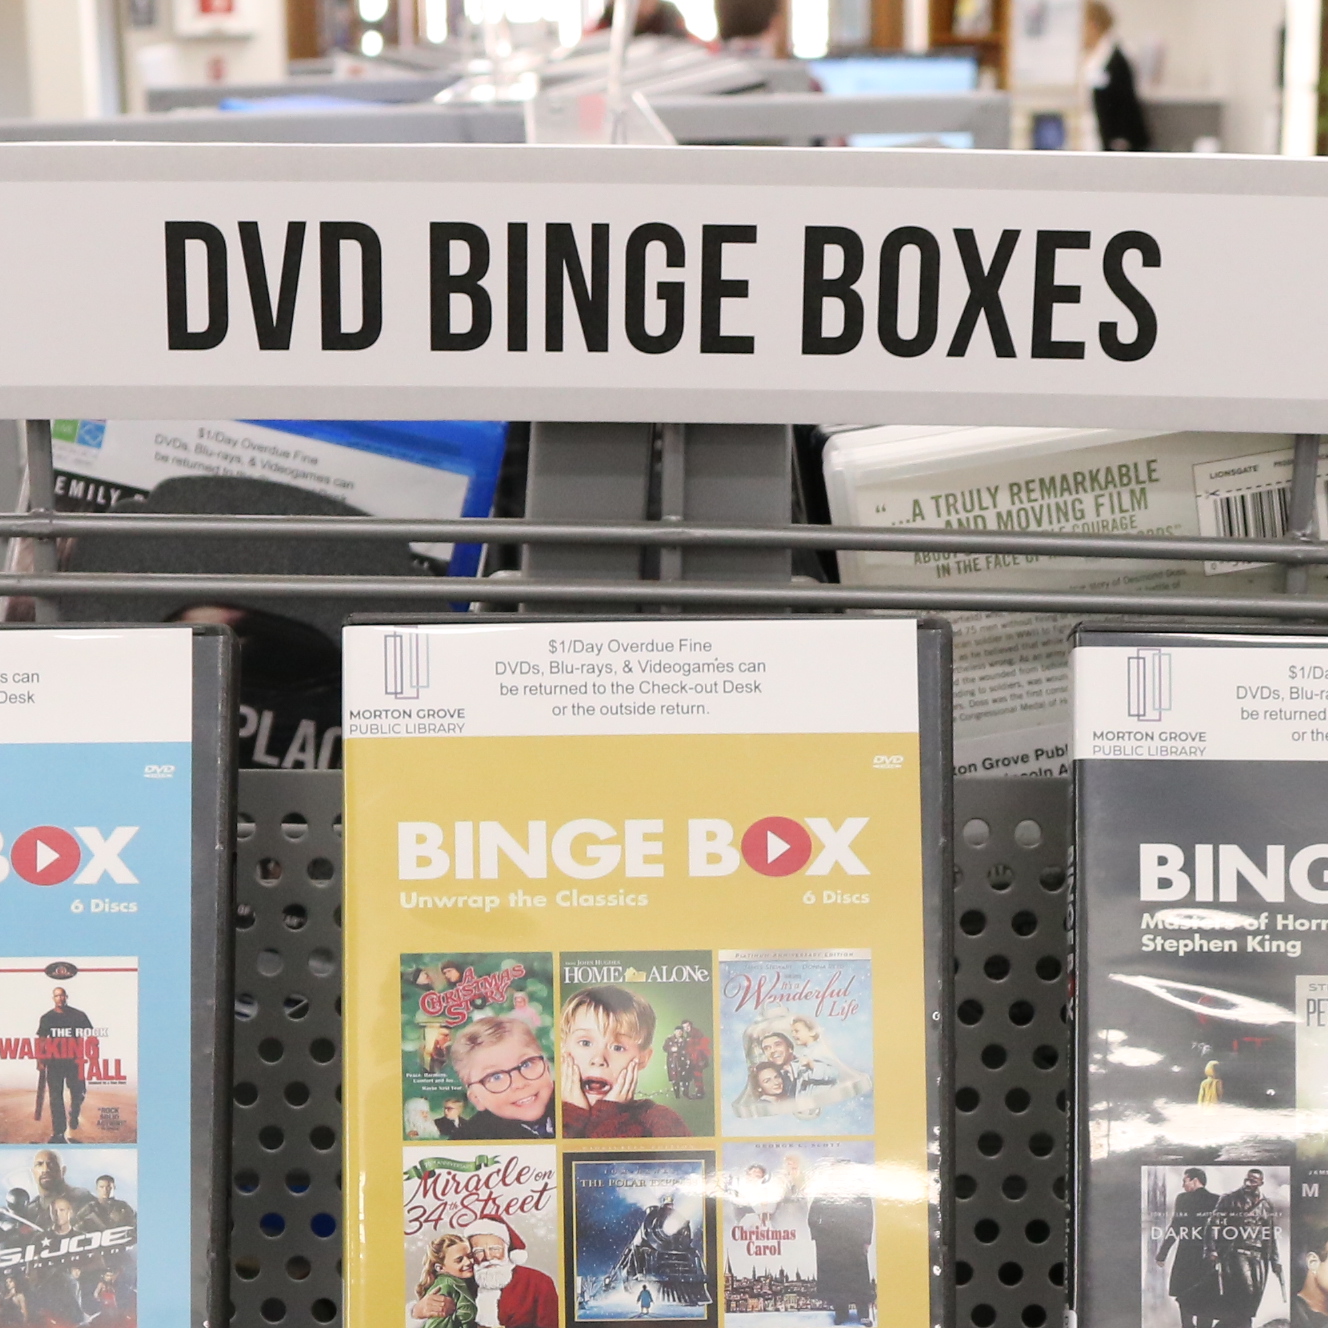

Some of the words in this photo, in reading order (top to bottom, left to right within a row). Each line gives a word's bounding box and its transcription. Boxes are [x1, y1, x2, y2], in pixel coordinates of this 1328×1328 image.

[164, 219, 386, 353] DVD
[429, 222, 757, 359] BINGE
[801, 226, 1163, 363] BOXES
[1209, 464, 1258, 480] LIONSGATE
[930, 486, 999, 520] TRULY
[1008, 459, 1160, 505] REMARKABLE
[996, 496, 1086, 532] MOVING
[1095, 486, 1148, 517] FILM
[548, 639, 603, 655] $1/Day
[607, 639, 674, 654] Overdue
[678, 639, 712, 654] Fine
[495, 660, 544, 677] DVDs,
[549, 659, 617, 676] Blu-rays,
[622, 660, 633, 673] &
[637, 659, 733, 676] Videogames
[738, 661, 766, 673] can
[500, 681, 519, 696] be
[524, 680, 586, 695] returned
[591, 681, 603, 695] to
[607, 680, 634, 695] the
[639, 680, 718, 695] Check-out
[723, 679, 762, 694] Desk
[1236, 686, 1285, 703] DVDs,
[350, 708, 410, 720] MORTON
[417, 708, 465, 719] GROVE
[552, 705, 567, 716] or
[571, 702, 594, 716] the
[599, 701, 656, 716] outside
[661, 702, 710, 715] return.
[1241, 707, 1260, 722] be
[1264, 707, 1326, 722] returned
[350, 723, 401, 735] PUBLIC
[406, 722, 465, 734] LIBRARY
[1093, 731, 1154, 742] MORTON
[1160, 731, 1206, 742] GROVE
[1292, 731, 1306, 742] or
[1093, 745, 1143, 756] PUBLIC
[1148, 745, 1206, 756] LIBRARY
[397, 819, 664, 880] BINGE
[688, 816, 871, 877] BOX
[400, 891, 500, 912] Unwrap
[510, 890, 547, 908] the
[555, 890, 648, 908] Classics
[803, 890, 815, 904] 6
[821, 890, 870, 904] Discs
[71, 899, 84, 914] 6
[90, 898, 137, 913] Discs
[1140, 935, 1241, 956] Stephen
[1247, 936, 1301, 957] King
[564, 966, 622, 984] HOME
[724, 971, 855, 1017] Wonderful
[828, 999, 859, 1021] Life
[51, 1028, 72, 1037] THE
[76, 1028, 108, 1037] ROCK
[76, 1059, 127, 1080] TALL
[404, 1155, 531, 1207] Miracle
[449, 1183, 557, 1228] Street
[731, 1226, 796, 1241] Christmas
[1151, 1226, 1202, 1240] DARK
[1212, 1226, 1283, 1240] TOWER
[747, 1241, 781, 1256] Carol
